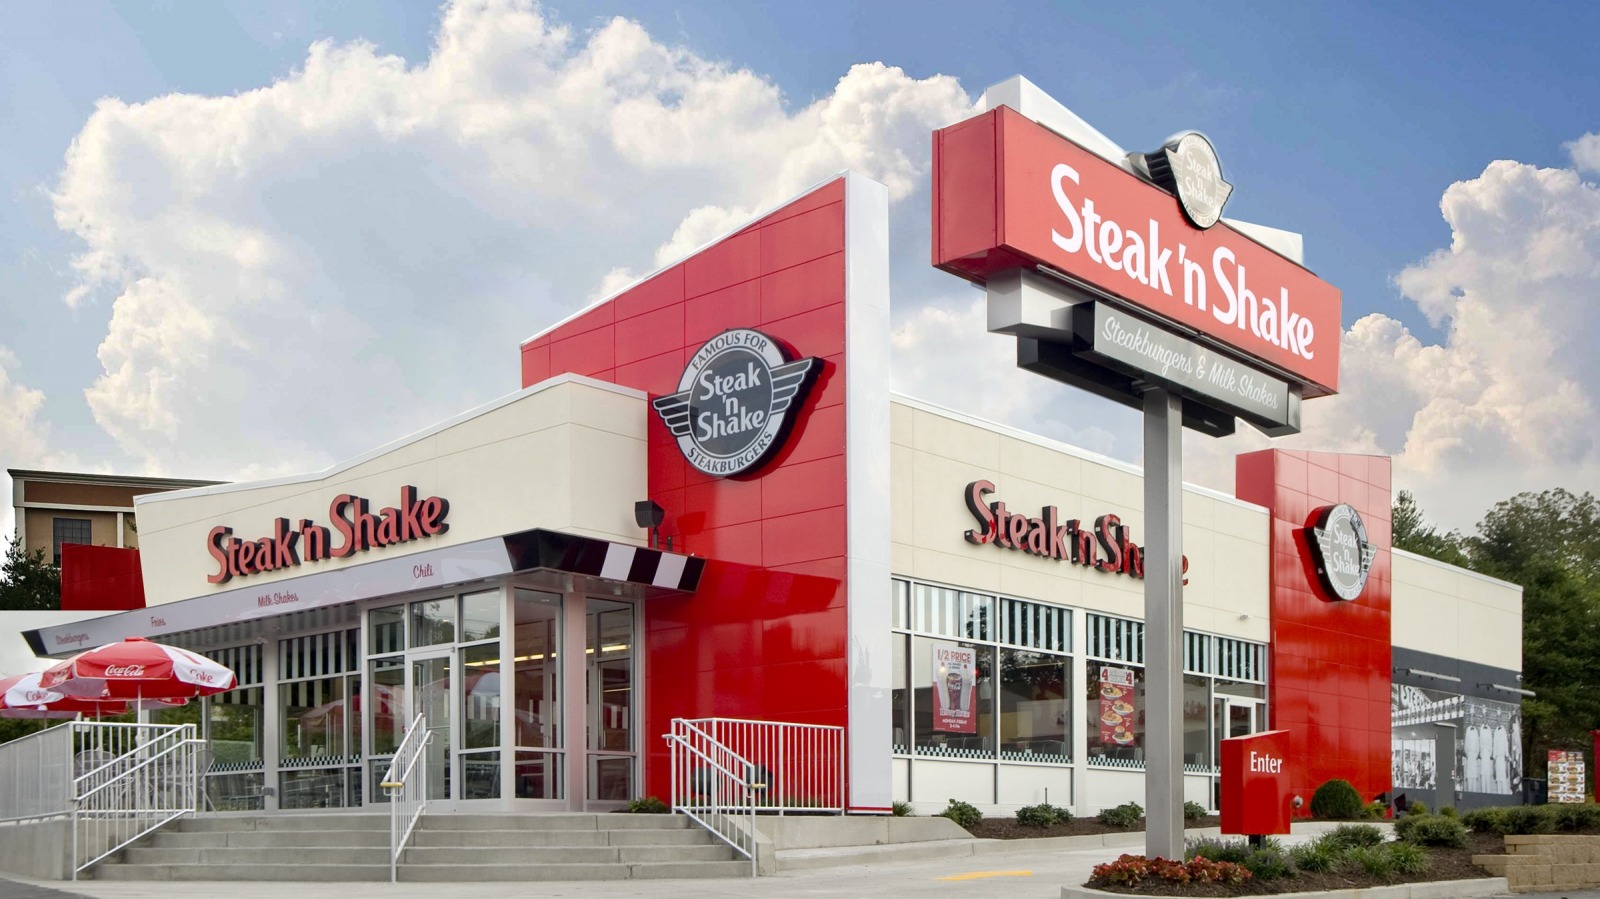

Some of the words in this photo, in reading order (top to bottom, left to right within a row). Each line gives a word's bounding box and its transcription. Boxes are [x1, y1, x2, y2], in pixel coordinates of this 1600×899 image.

[1186, 151, 1213, 182] Steak
[1184, 176, 1214, 208] Shake
[1051, 163, 1173, 296] Steak
[1212, 246, 1314, 360] Shake
[691, 332, 741, 371] FAMOUS
[743, 332, 768, 353] FOR
[1102, 316, 1193, 376] Steakburgers
[1196, 355, 1206, 379] &
[1208, 362, 1237, 392] Milk
[1237, 374, 1279, 409] Shakes
[699, 361, 762, 401] Steak
[697, 406, 765, 442] Shake
[687, 430, 773, 473] STEAKBURGERS
[207, 516, 301, 584] Steak
[329, 484, 450, 558] Shake
[964, 479, 1069, 562] Steak
[1094, 513, 1189, 586] She
[1334, 523, 1358, 549] Steak
[413, 563, 434, 579] Chili
[1333, 551, 1361, 577] Shake
[258, 594, 273, 608] Milk
[274, 590, 299, 605] Shakes
[937, 649, 950, 661] 1/2
[950, 651, 971, 664] PRICE
[189, 668, 214, 683] Coke
[1102, 668, 1109, 681] 4
[1126, 671, 1133, 685] 4
[1250, 751, 1282, 773] Enter
